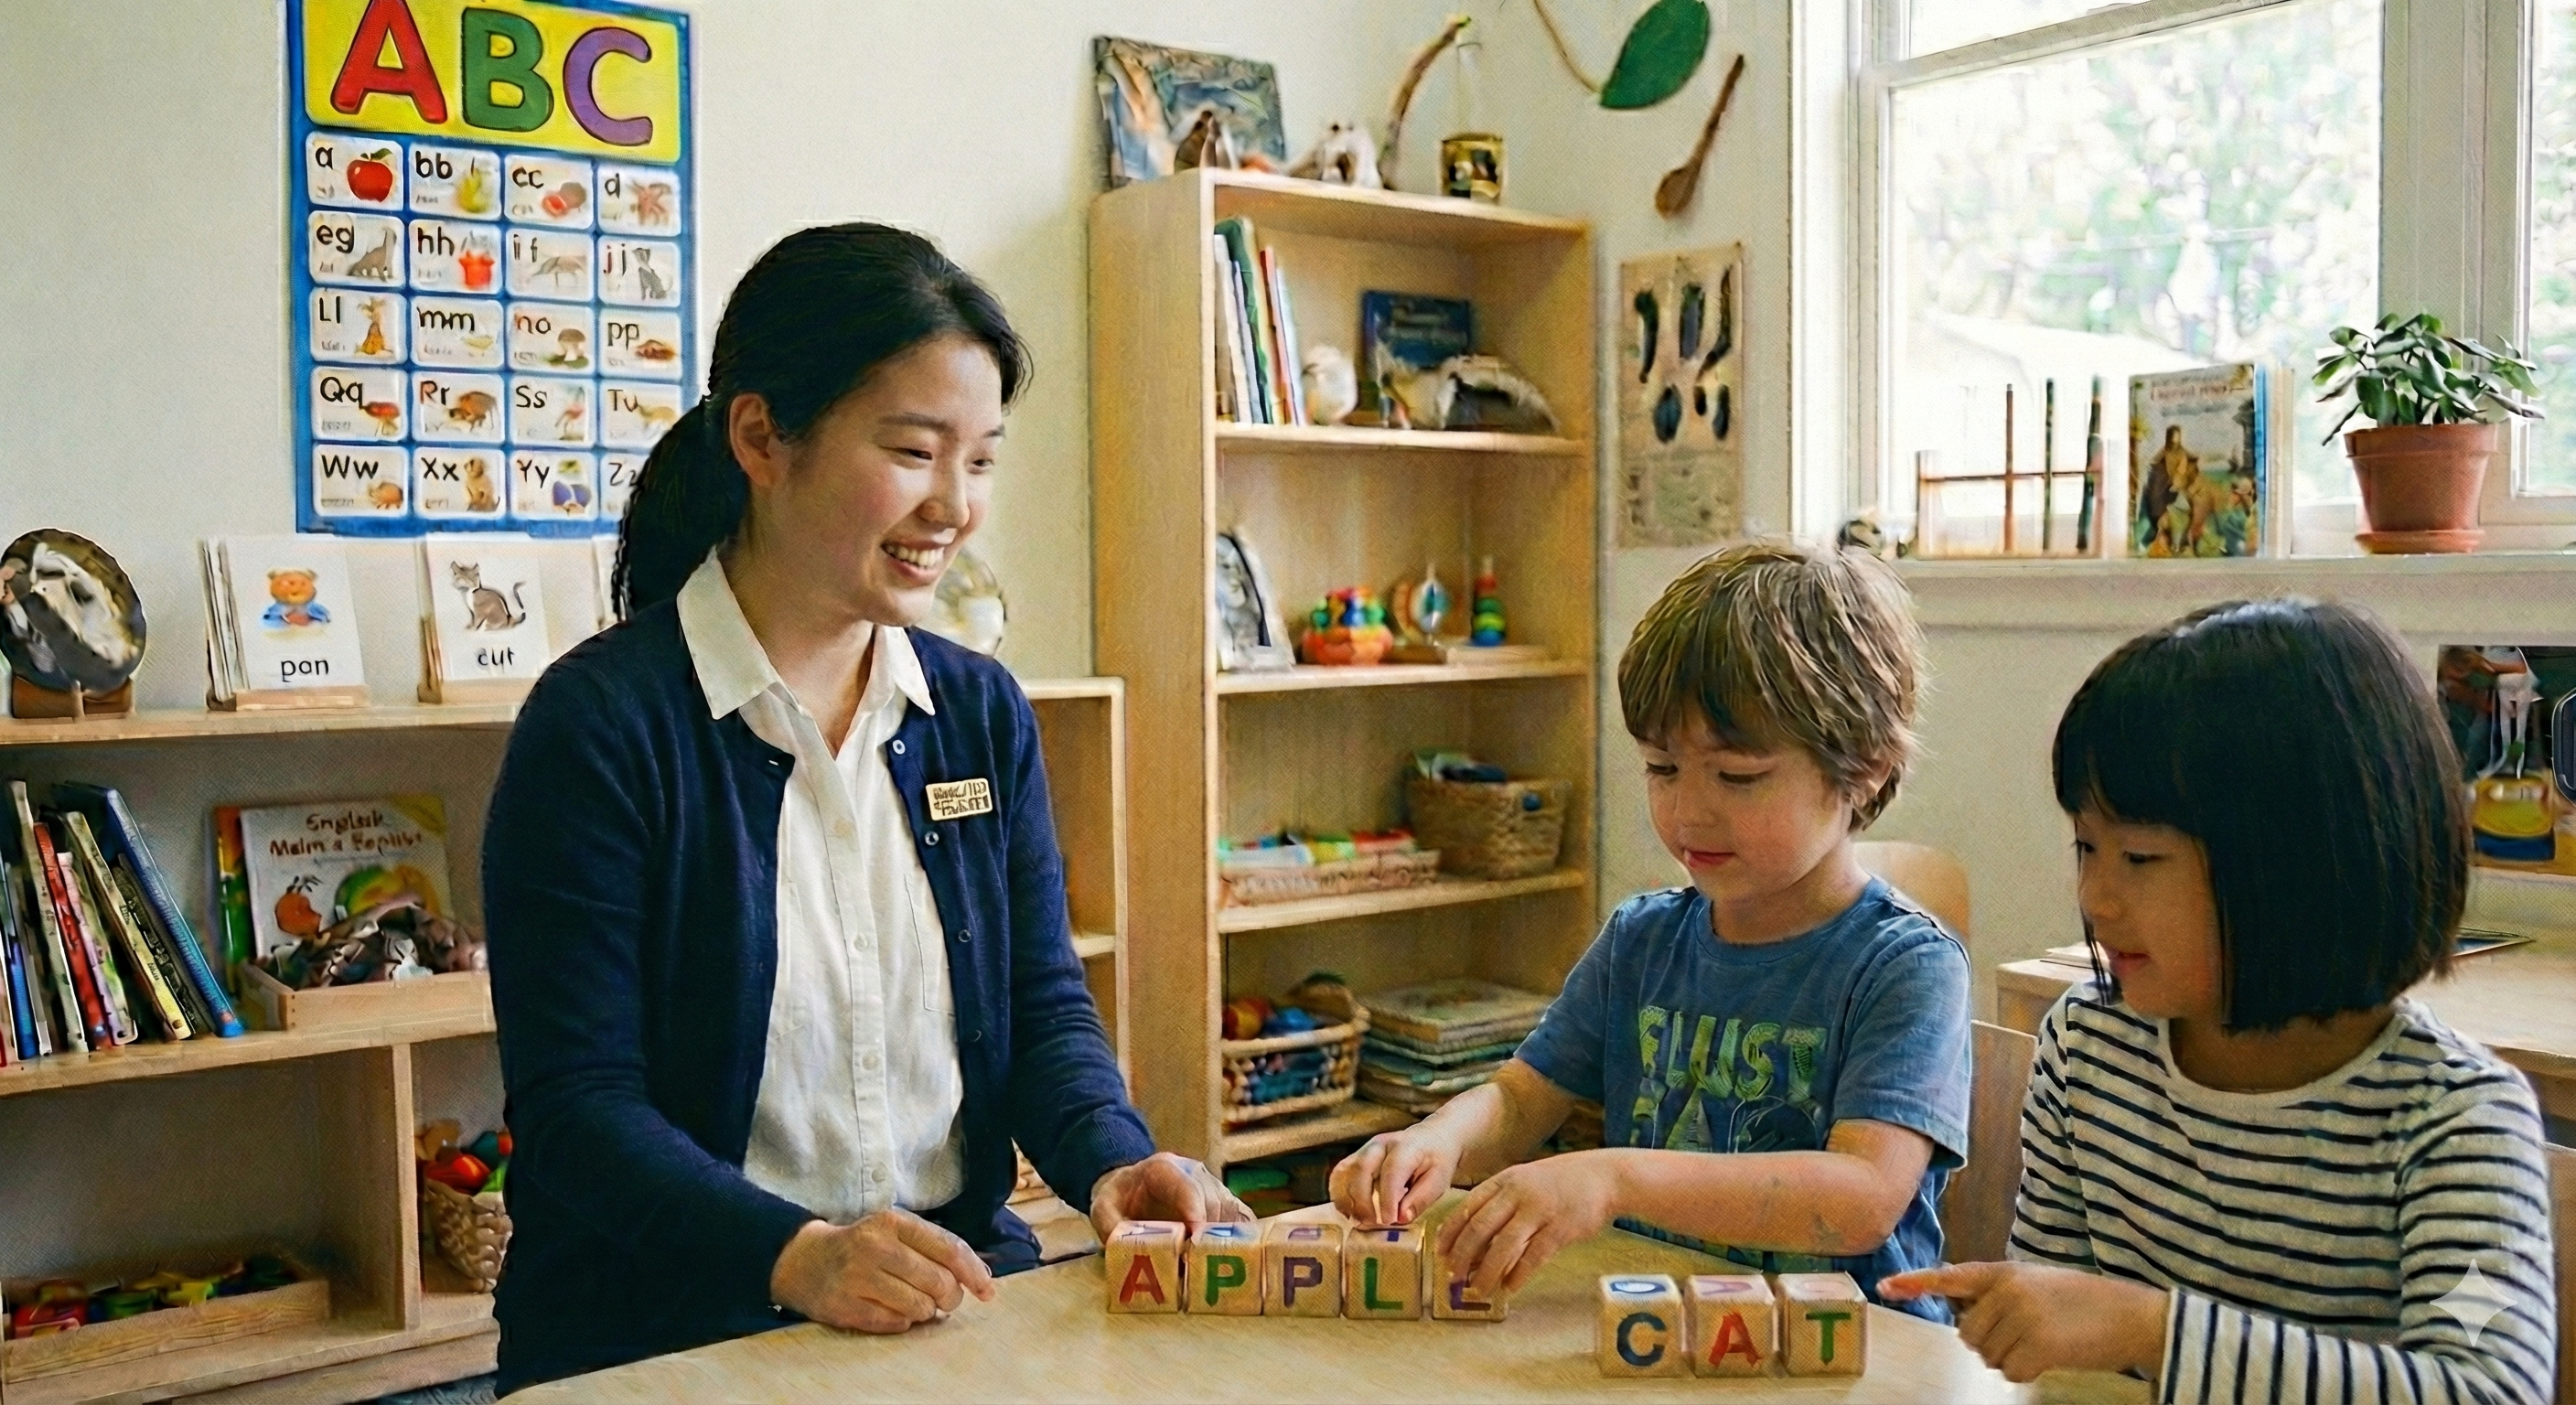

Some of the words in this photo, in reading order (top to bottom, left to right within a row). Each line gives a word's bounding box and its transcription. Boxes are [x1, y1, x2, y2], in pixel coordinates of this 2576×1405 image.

[330, 0, 652, 145] ABC
[315, 146, 334, 170] a
[415, 151, 453, 179] bb
[605, 173, 621, 198] d
[316, 224, 356, 254] eg
[417, 226, 456, 256] hh
[607, 322, 639, 351] pp
[320, 376, 363, 410] Qq
[420, 381, 450, 405] Rr
[515, 385, 548, 408] Ss
[321, 455, 379, 480] Ww
[421, 456, 460, 481] Xx
[516, 458, 551, 488] Yy
[1616, 1311, 1852, 1368] CAT
